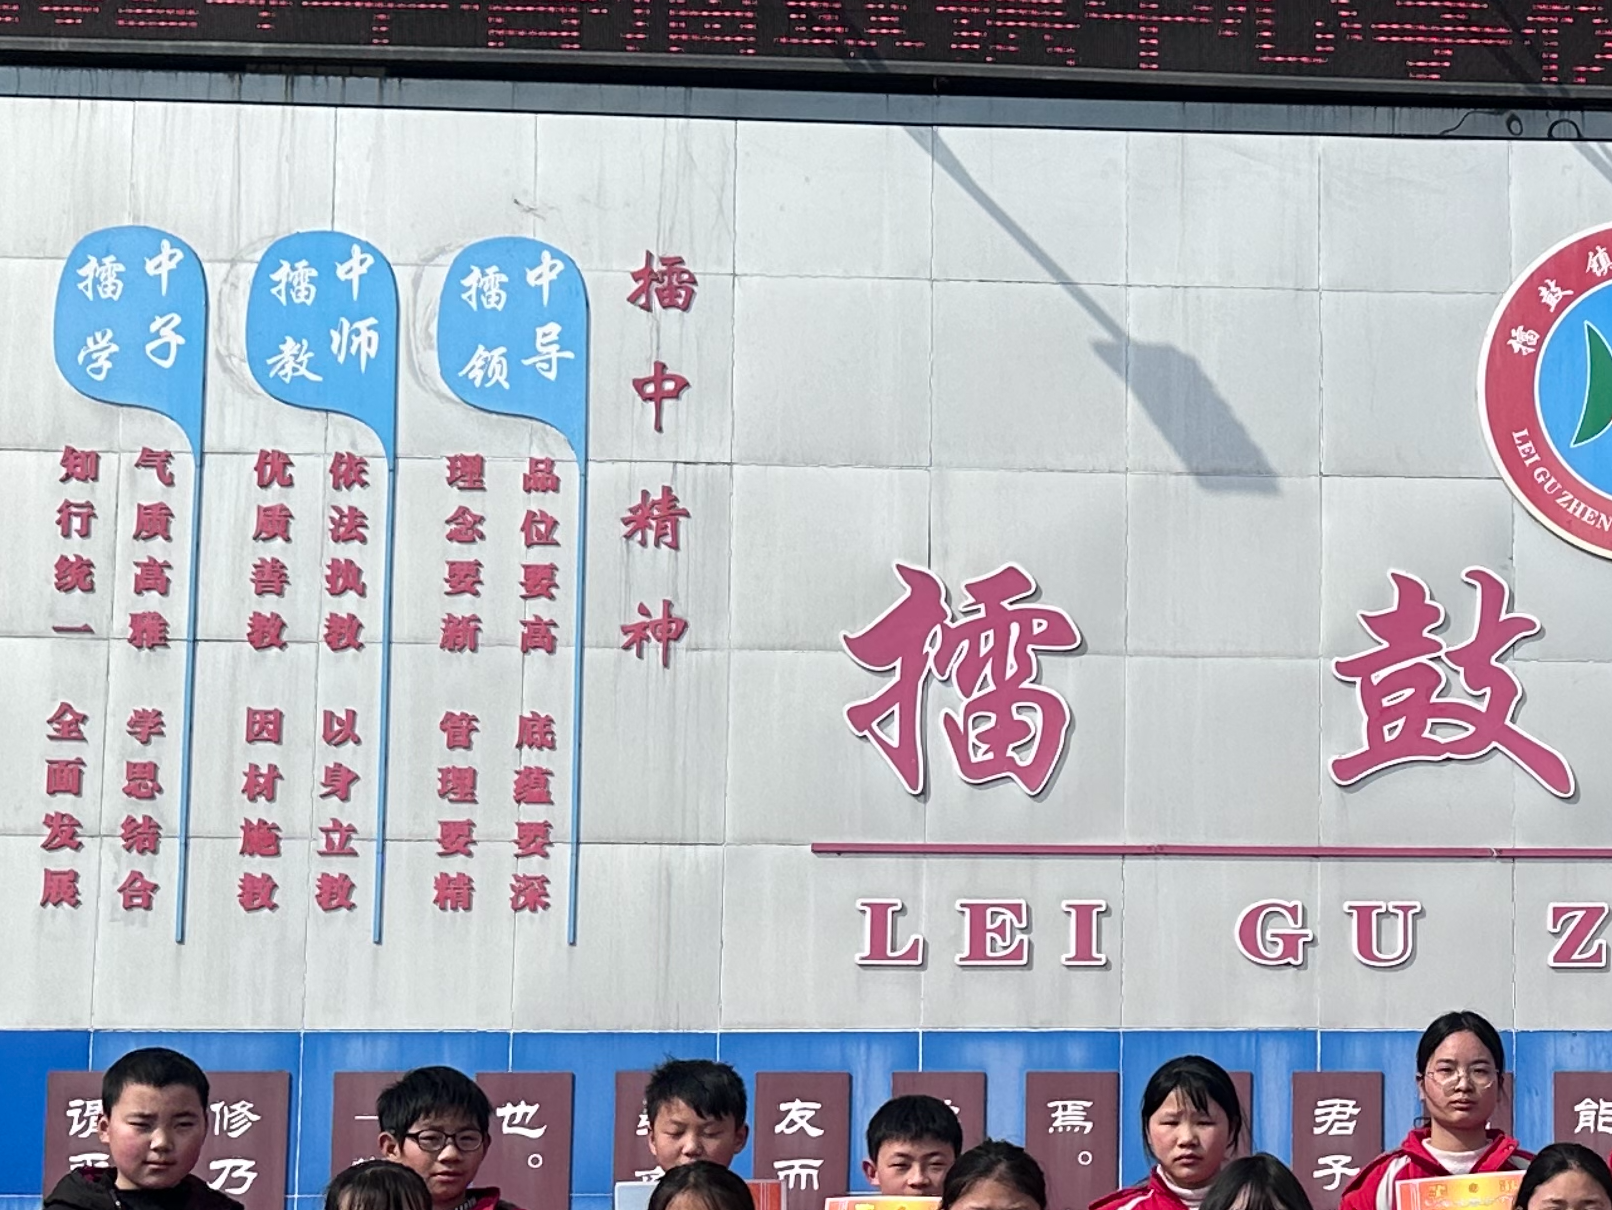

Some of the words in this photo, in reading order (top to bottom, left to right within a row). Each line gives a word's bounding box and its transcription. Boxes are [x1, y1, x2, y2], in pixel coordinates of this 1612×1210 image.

[76, 240, 186, 301] 擂中
[76, 314, 187, 382] 学子
[266, 316, 380, 385] 教师
[269, 243, 377, 308] 擂中
[457, 322, 576, 391] 领导
[459, 250, 565, 313] 擂中
[53, 446, 99, 636] 知行统一
[128, 447, 176, 651] 气质高雅
[245, 449, 295, 652] 优质善教
[323, 451, 370, 653] 依法执教
[439, 454, 488, 653] 理念要新
[518, 457, 562, 656] 品位要高
[620, 250, 699, 669] 擂中精神
[1511, 427, 1540, 468] LEI
[1532, 465, 1562, 496] GU
[1555, 489, 1612, 532] ZHEN
[40, 701, 89, 908] 全面发展
[117, 707, 166, 911] 学思结合
[237, 707, 284, 912] 因材施教
[314, 707, 362, 911] 以身立教
[432, 710, 480, 912] 管理要精
[508, 710, 558, 913] 底蕴要深
[860, 899, 1106, 966] LEI
[1235, 899, 1422, 967] GU
